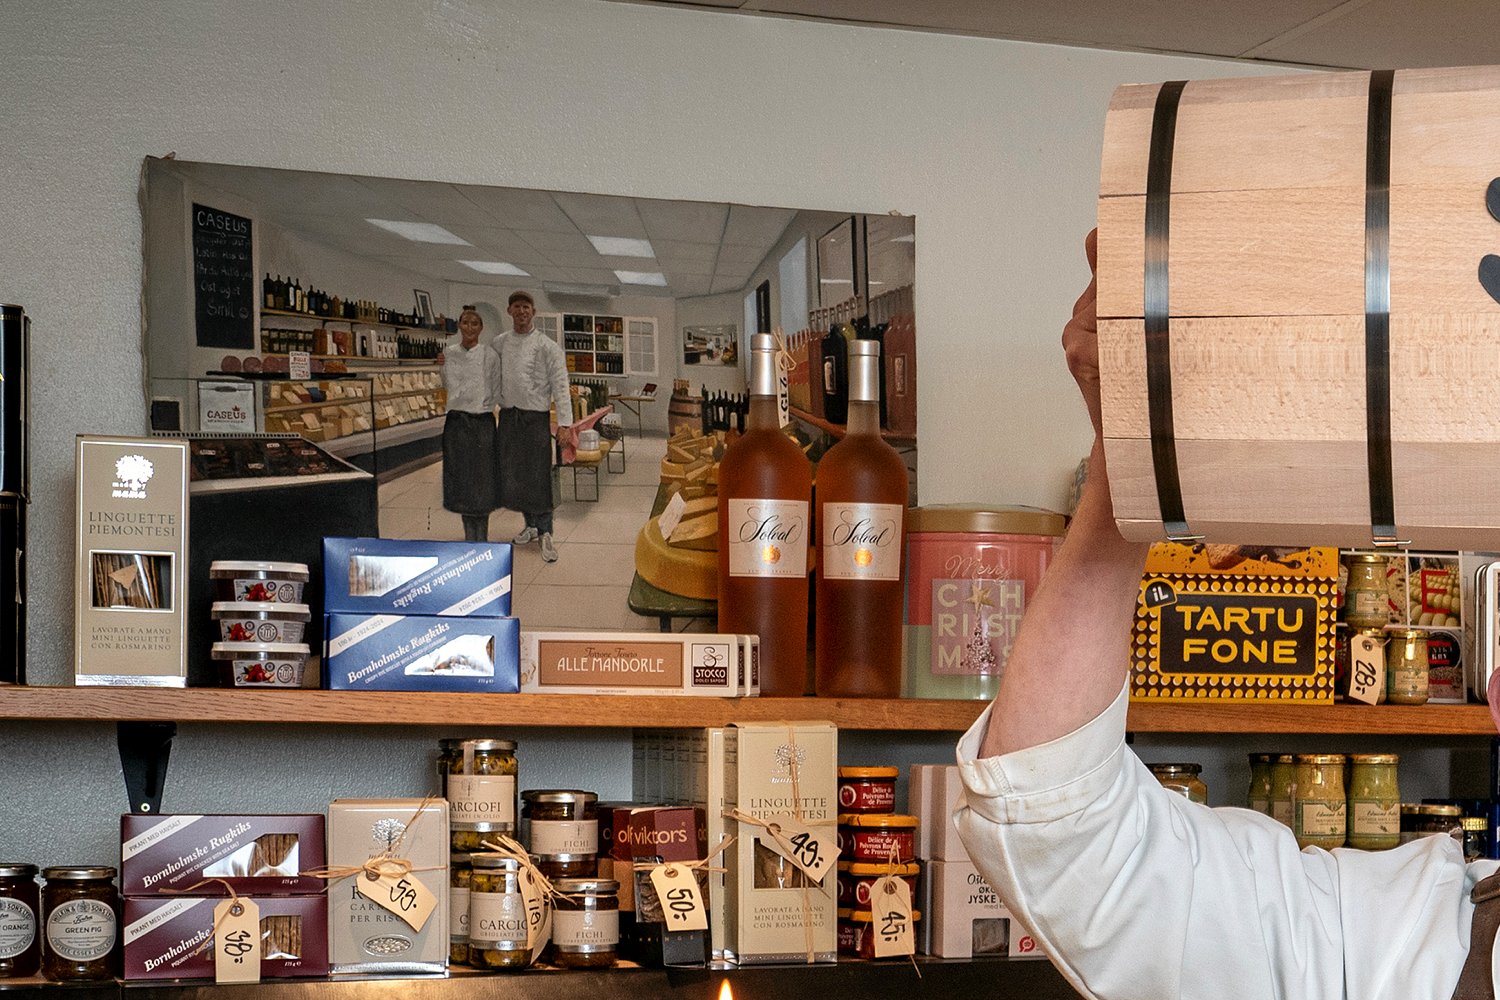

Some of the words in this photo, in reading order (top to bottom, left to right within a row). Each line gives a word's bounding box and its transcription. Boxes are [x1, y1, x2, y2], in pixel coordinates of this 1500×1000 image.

[198, 211, 247, 232] CASEUS
[207, 410, 246, 419] CASEUS
[90, 512, 175, 524] LINGUETTE
[89, 524, 175, 536] PIEMONTESI
[432, 549, 494, 586] Bornholmske
[393, 578, 432, 609] Rugkiks
[1176, 605, 1303, 635] TARTU
[1183, 639, 1299, 664] FONE
[347, 643, 410, 683] Bornholmske
[557, 657, 589, 672] ALLE
[592, 657, 665, 673] MANDORLE
[695, 668, 726, 678] STOCCO
[451, 802, 500, 812] ARCIOFI
[142, 846, 208, 888] Bornholmske
[209, 821, 251, 850] Rugkiks
[968, 895, 996, 904] JYSKE
[130, 921, 149, 936] PIKANT
[149, 915, 162, 928] MED
[161, 903, 183, 921] HAVSALT
[350, 914, 372, 923] PER
[144, 928, 211, 972] Bornholmske
